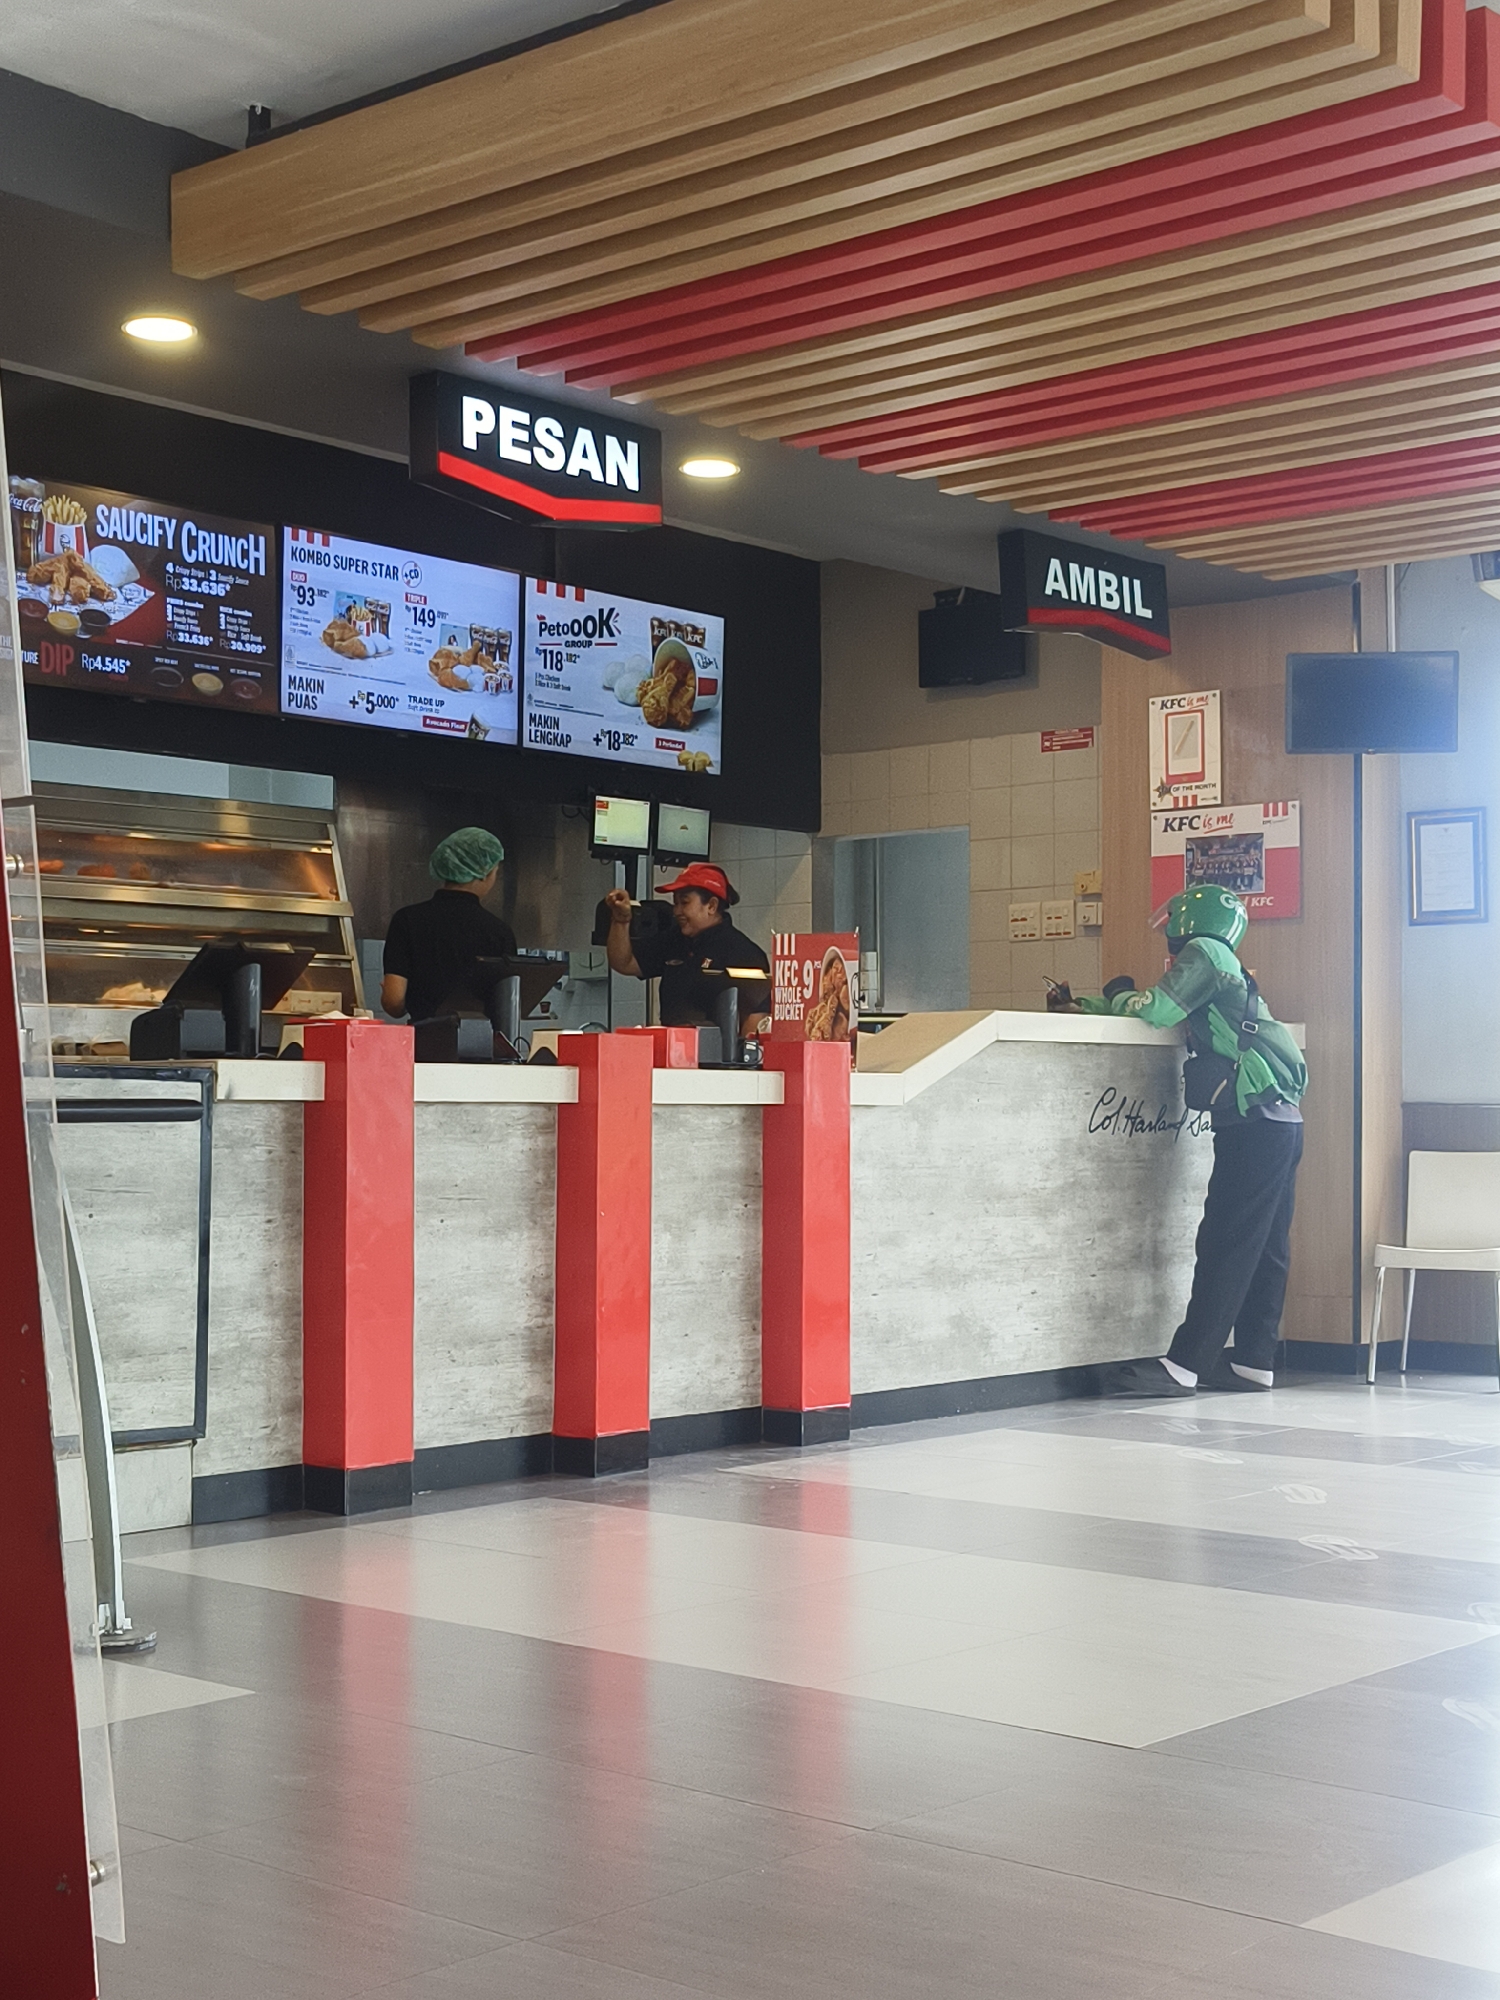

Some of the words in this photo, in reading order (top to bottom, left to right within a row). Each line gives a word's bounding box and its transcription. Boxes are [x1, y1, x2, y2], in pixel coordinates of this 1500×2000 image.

[462, 395, 640, 492] PESAN
[96, 504, 177, 550] SAUCIFY
[181, 521, 266, 576] CRUNCH
[166, 562, 174, 574] 4
[209, 569, 217, 581] 3
[290, 546, 331, 568] KOMBO
[333, 554, 369, 576] SUPER
[371, 562, 399, 582] STAR
[1044, 557, 1153, 619] AMBIL
[564, 640, 593, 649] GROUP
[41, 641, 74, 676] DIP
[288, 675, 324, 695] MAKIN
[287, 692, 318, 711] PUAS
[408, 694, 434, 707] TRADE
[434, 699, 445, 708] UP
[1160, 697, 1186, 710] KFC
[529, 713, 560, 731] MAKIN
[528, 729, 572, 748] LENGKAP
[1172, 785, 1181, 793] OF
[1182, 783, 1193, 792] THE
[1195, 782, 1217, 791] MONTH
[1162, 815, 1200, 833] KFC
[1202, 814, 1213, 829] is
[1216, 812, 1235, 826] me
[1251, 896, 1274, 907] KFC
[775, 960, 799, 987] KFC
[803, 960, 814, 999] 9
[774, 986, 802, 1004] WHOLE
[774, 1003, 805, 1021] BUCKET
[1122, 1100, 1189, 1144] Harland
[1187, 1112, 1213, 1138] Sa
